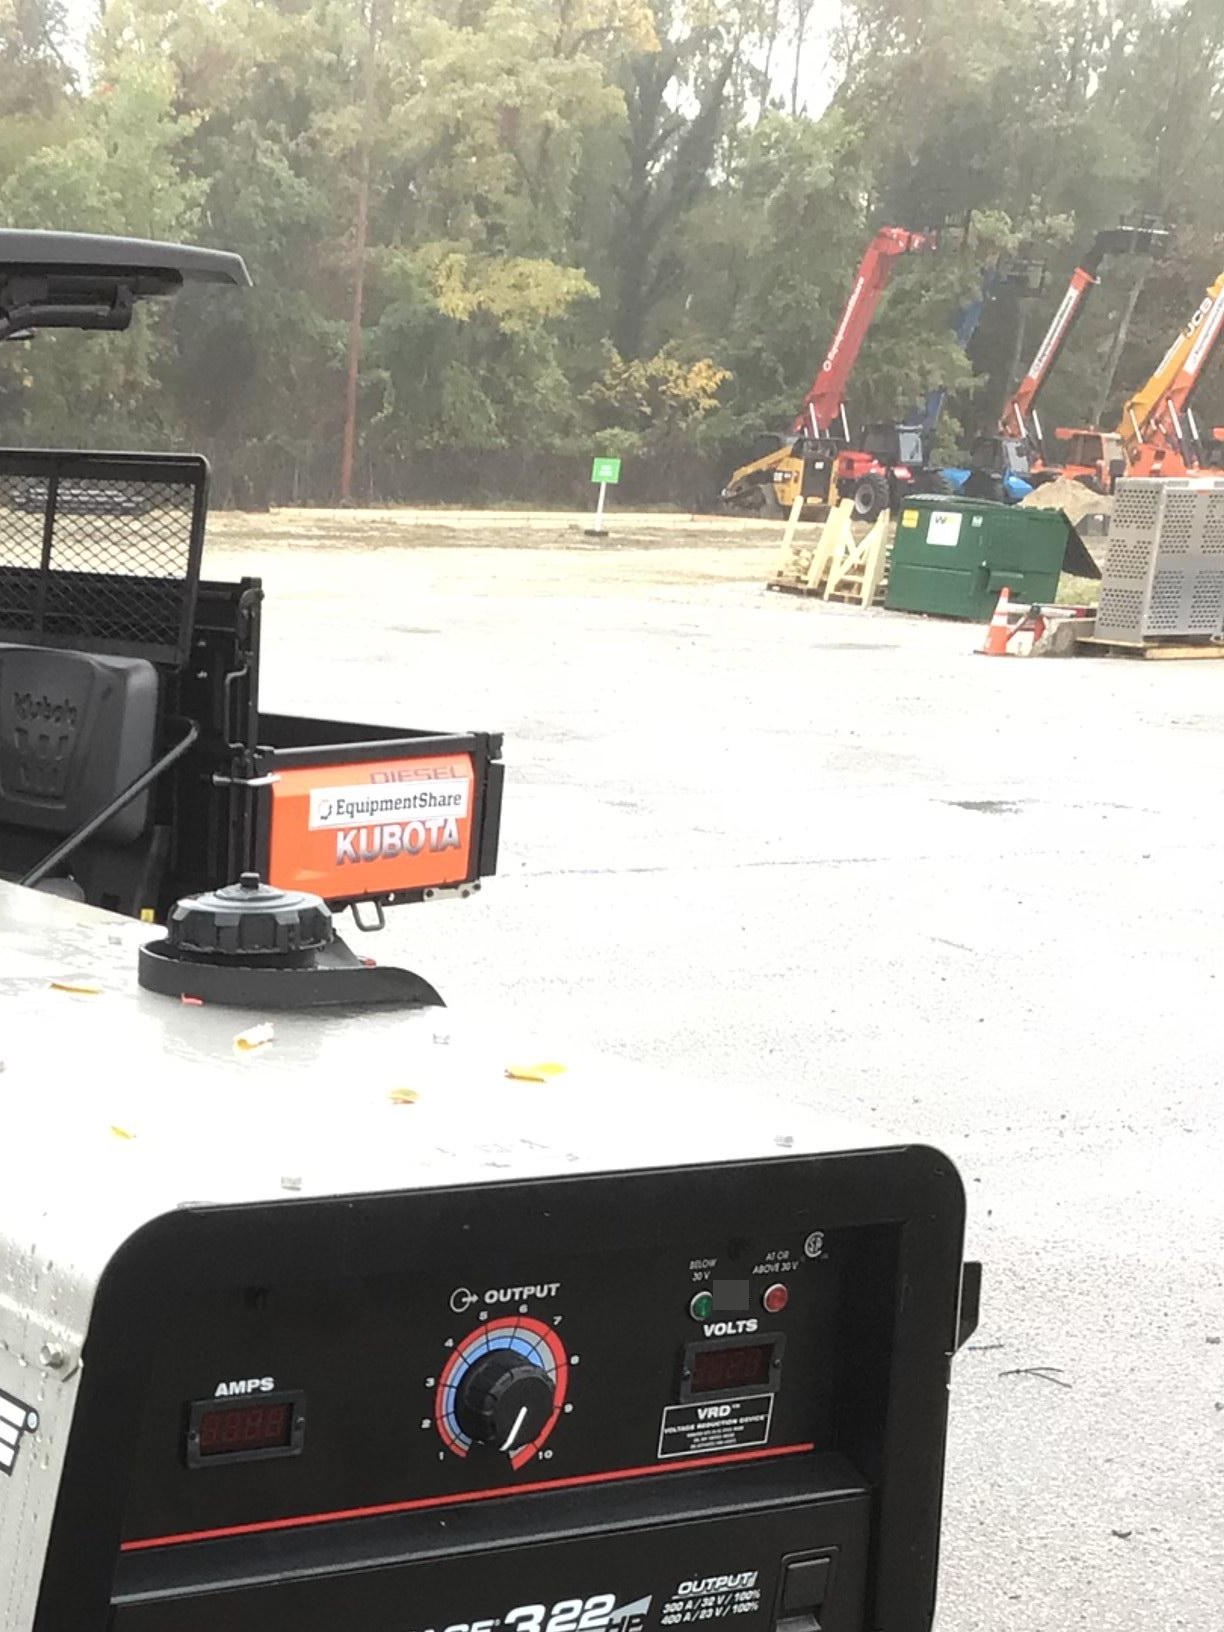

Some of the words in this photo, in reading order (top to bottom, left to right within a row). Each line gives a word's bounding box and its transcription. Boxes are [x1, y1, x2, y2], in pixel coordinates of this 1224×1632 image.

[336, 791, 462, 818] EquipmentShare
[335, 818, 462, 865] KUBOTA
[484, 1282, 561, 1305] OUTPUT
[519, 1304, 529, 1314] 6
[479, 1311, 489, 1321] 5
[553, 1315, 563, 1326] 7
[702, 1318, 759, 1338] VOLTS
[444, 1338, 455, 1348] 4
[214, 1376, 276, 1398] AMPS
[425, 1377, 436, 1387] 3
[564, 1403, 574, 1414] 9
[421, 1419, 432, 1429] 2
[538, 1450, 554, 1460] 10
[678, 1571, 754, 1595] OUTPUT
